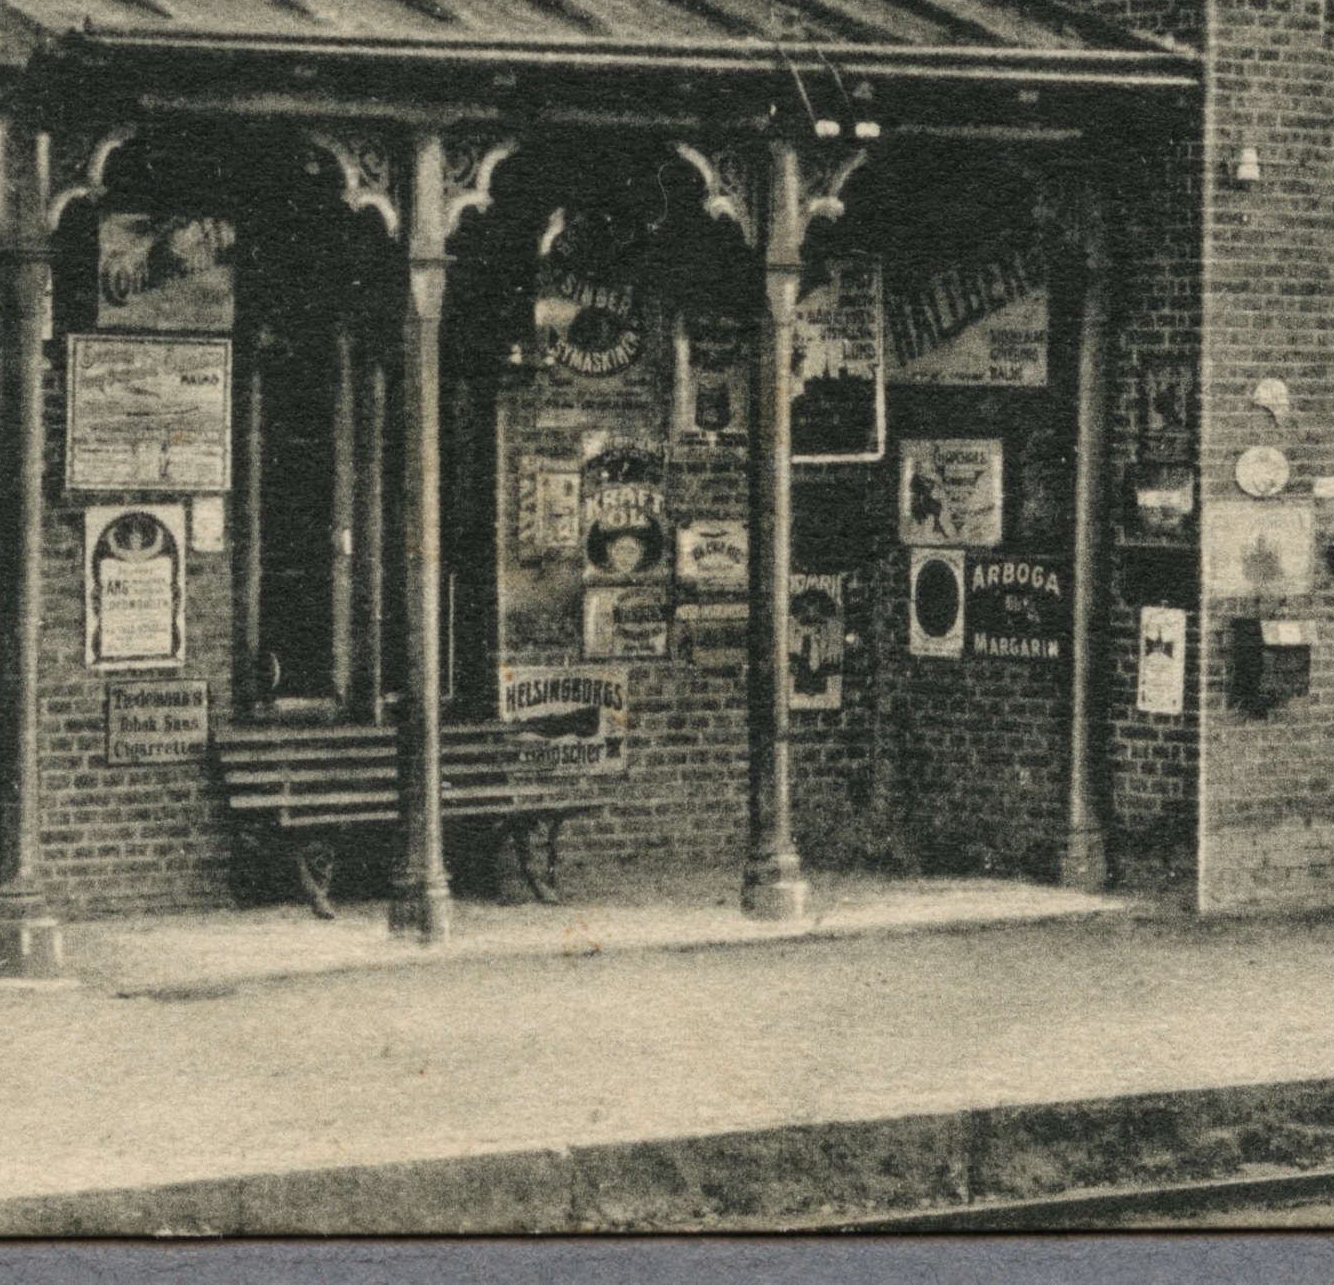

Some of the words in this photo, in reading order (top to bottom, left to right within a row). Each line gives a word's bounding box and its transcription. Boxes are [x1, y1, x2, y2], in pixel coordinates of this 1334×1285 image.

[585, 487, 665, 519] KRAFT
[971, 562, 1062, 598] ARBOGA
[973, 633, 1060, 659] MARGARIN
[505, 677, 623, 712] HELSINGBORGS
